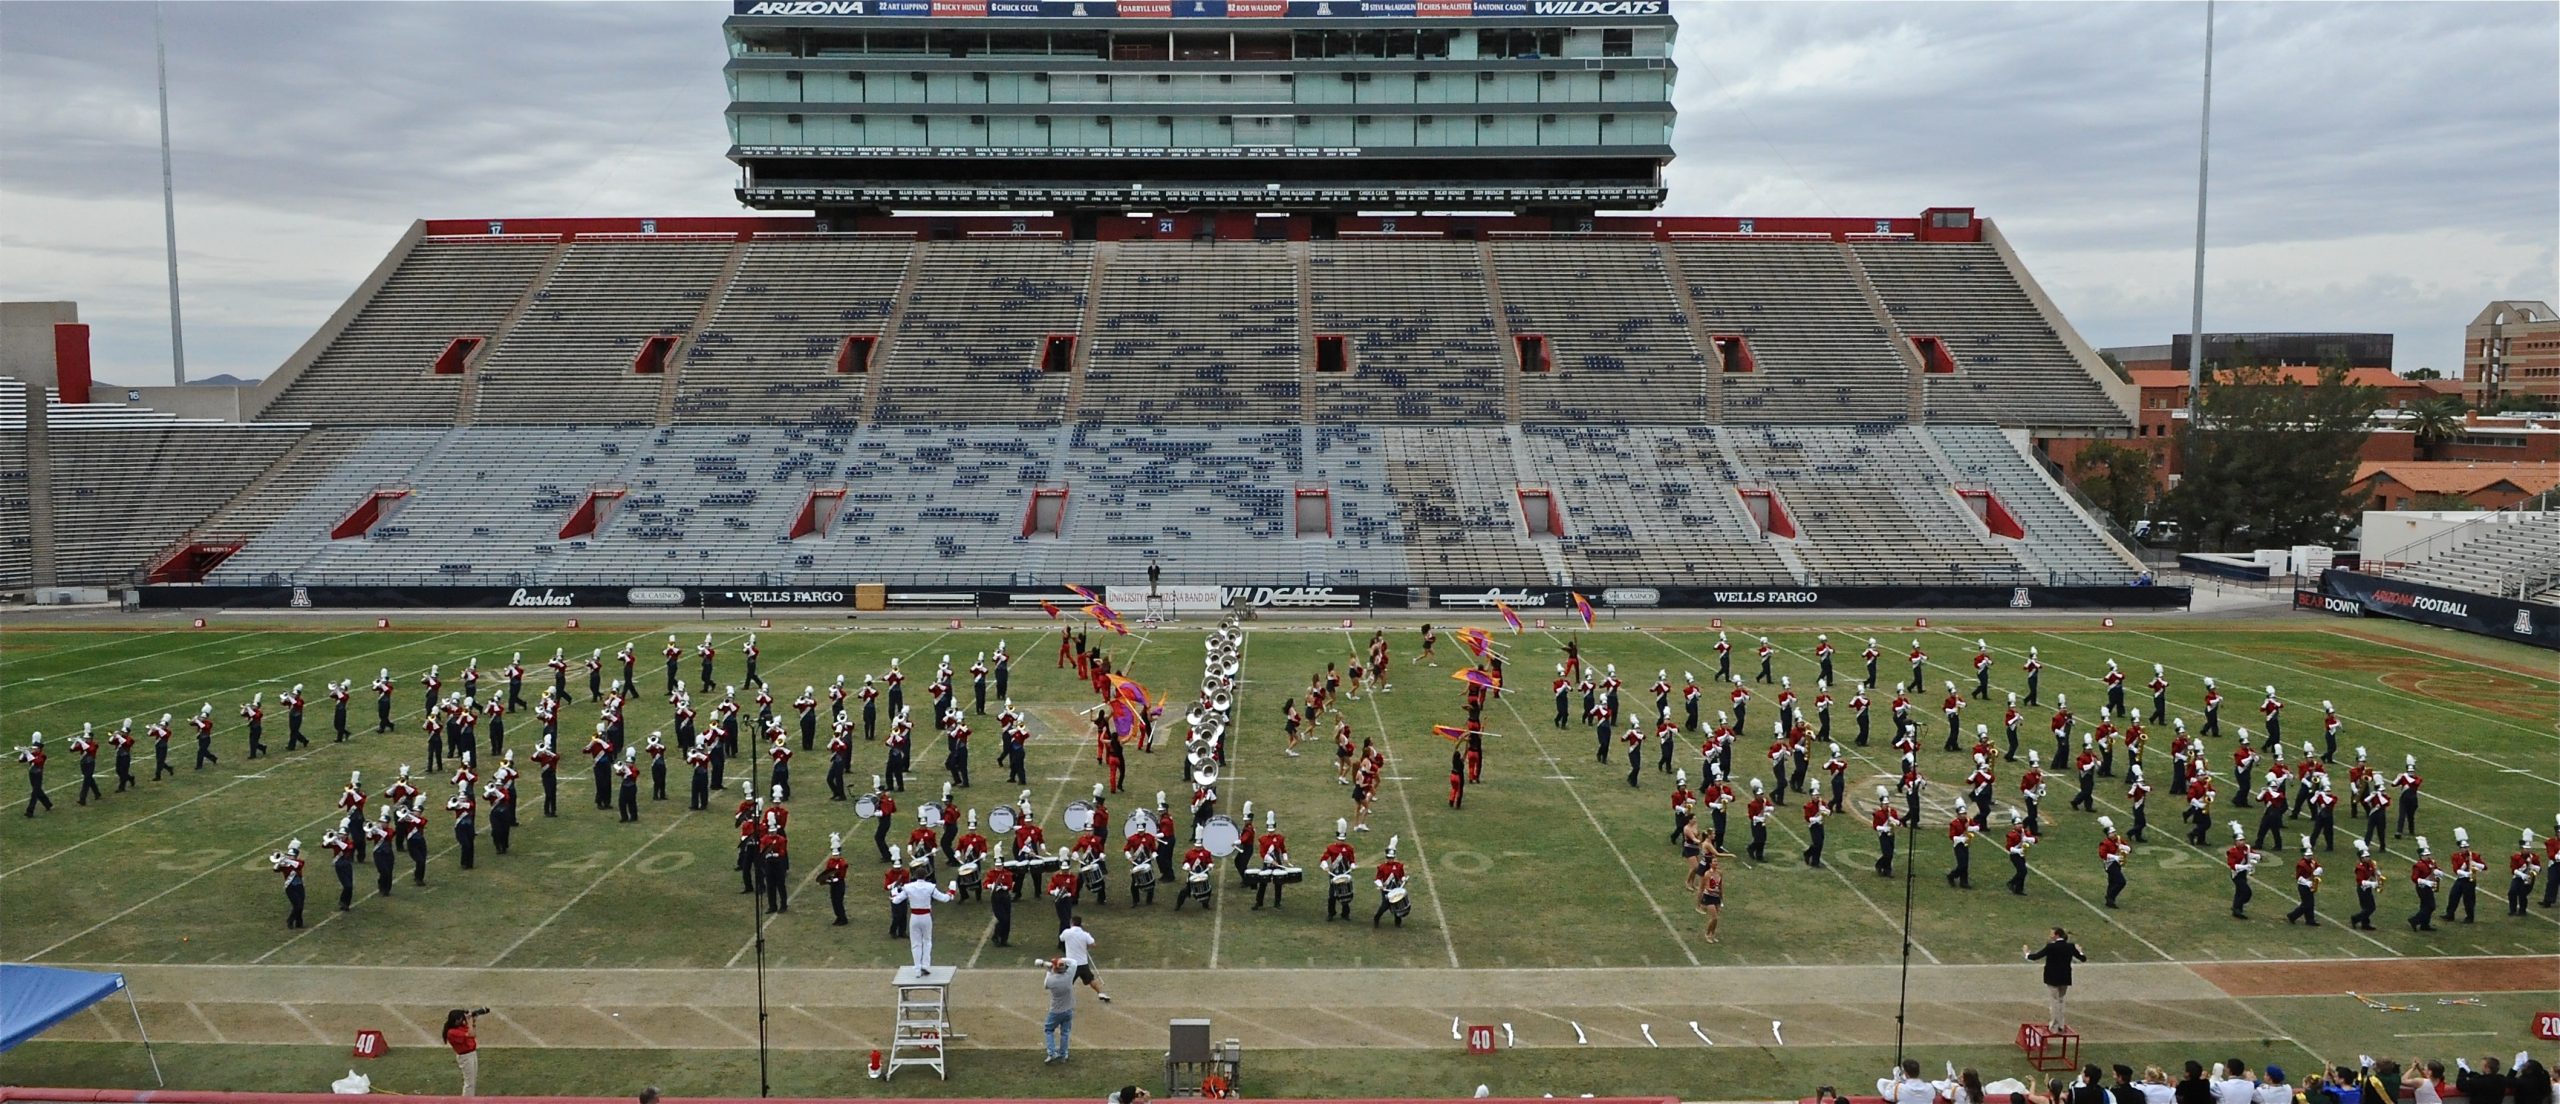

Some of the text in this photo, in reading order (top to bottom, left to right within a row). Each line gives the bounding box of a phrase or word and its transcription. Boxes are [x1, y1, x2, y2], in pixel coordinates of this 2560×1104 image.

[747, 1, 864, 15] ARIZONA
[879, 2, 888, 10] 22
[888, 2, 900, 10] ART
[1534, 1, 1662, 15] WILDCATS
[491, 226, 502, 234] 17
[643, 224, 654, 233] 18
[816, 223, 828, 232] 19
[1012, 223, 1026, 231] 20
[1160, 223, 1172, 232] 21
[1382, 223, 1395, 232] 22
[1580, 223, 1592, 232] 23
[1740, 224, 1752, 233] 24
[1876, 225, 1889, 234] 25
[128, 391, 140, 400] 16
[508, 588, 574, 606] Bashas'
[738, 592, 844, 602] WELLS FARGO
[1110, 592, 1144, 602] UNIVERSITY
[1184, 592, 1203, 602] BAND
[1204, 592, 1217, 602] DAY
[1714, 592, 1818, 602] WELLS FARGO
[2325, 598, 2360, 615] DOWN
[2413, 596, 2468, 617] FOOTBALL
[1472, 1030, 1490, 1048] 40
[356, 1034, 375, 1054] 40
